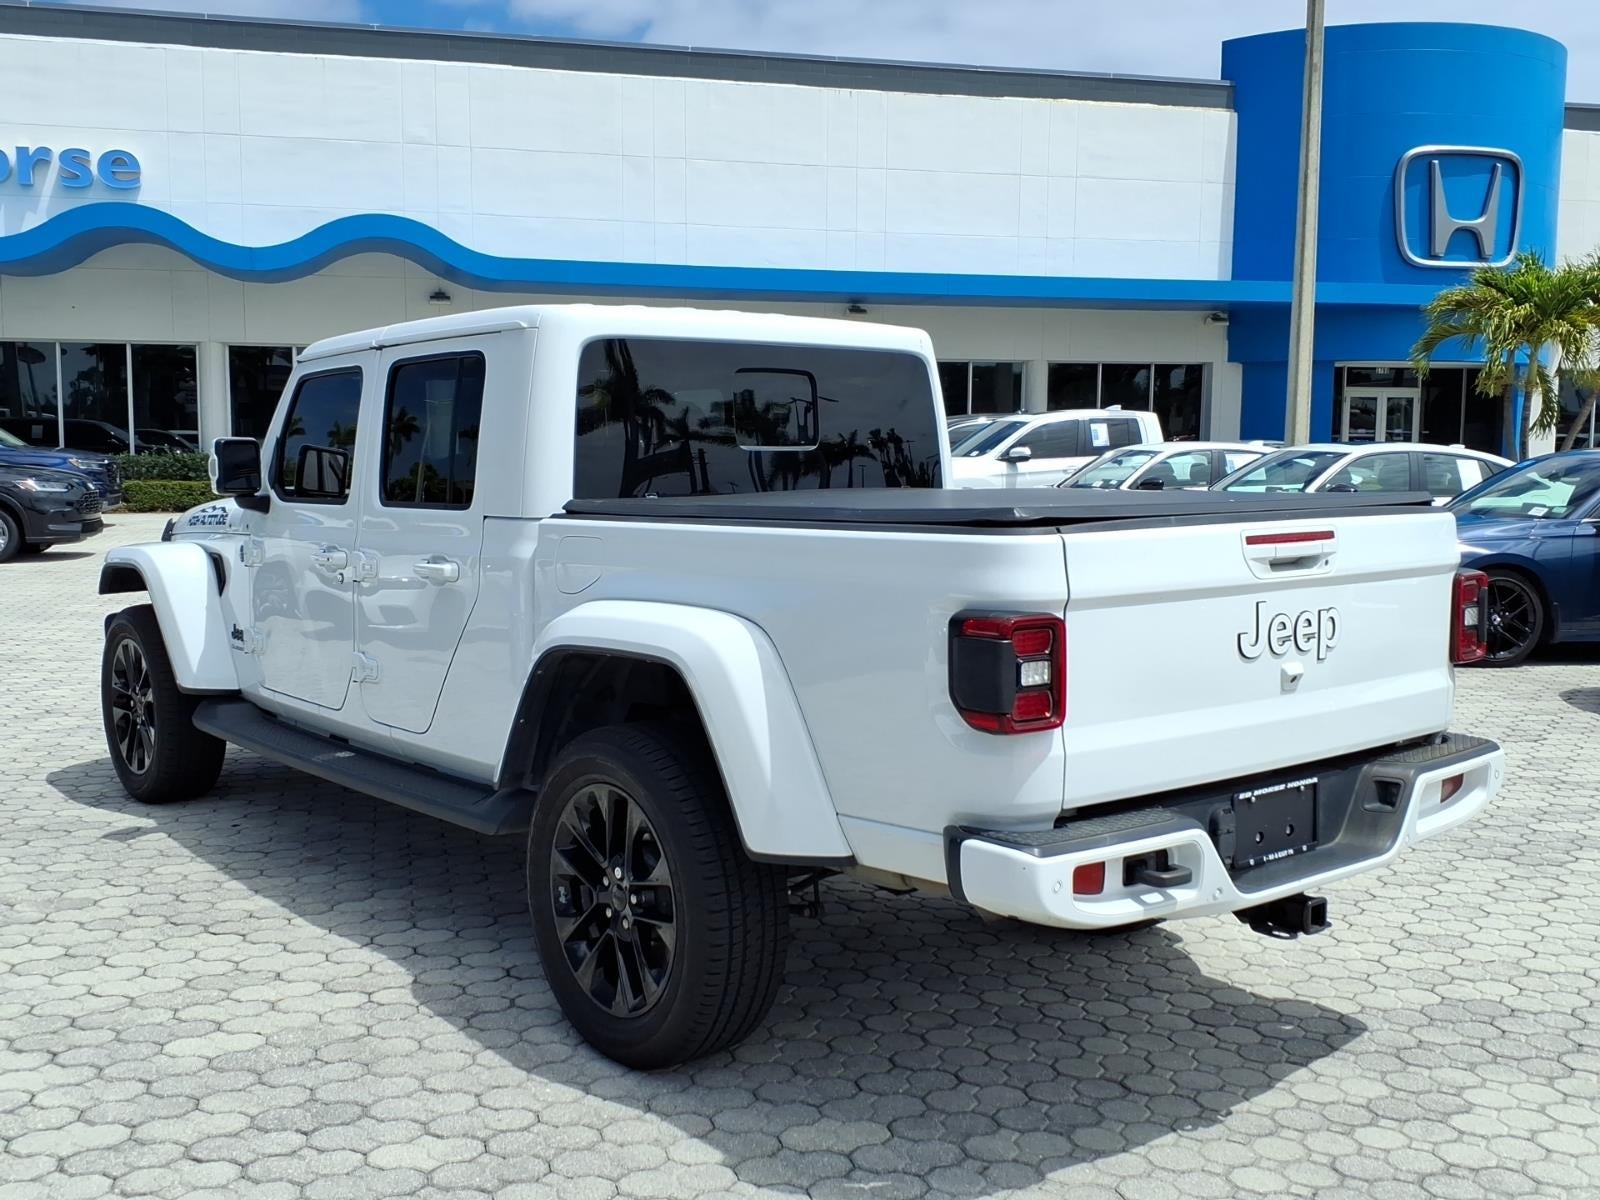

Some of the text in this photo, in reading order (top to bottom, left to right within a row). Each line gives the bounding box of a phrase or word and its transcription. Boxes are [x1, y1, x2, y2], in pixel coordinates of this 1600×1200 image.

[0, 145, 142, 190] rse
[1237, 600, 1341, 661] Jeep
[1286, 777, 1318, 789] HONDA
